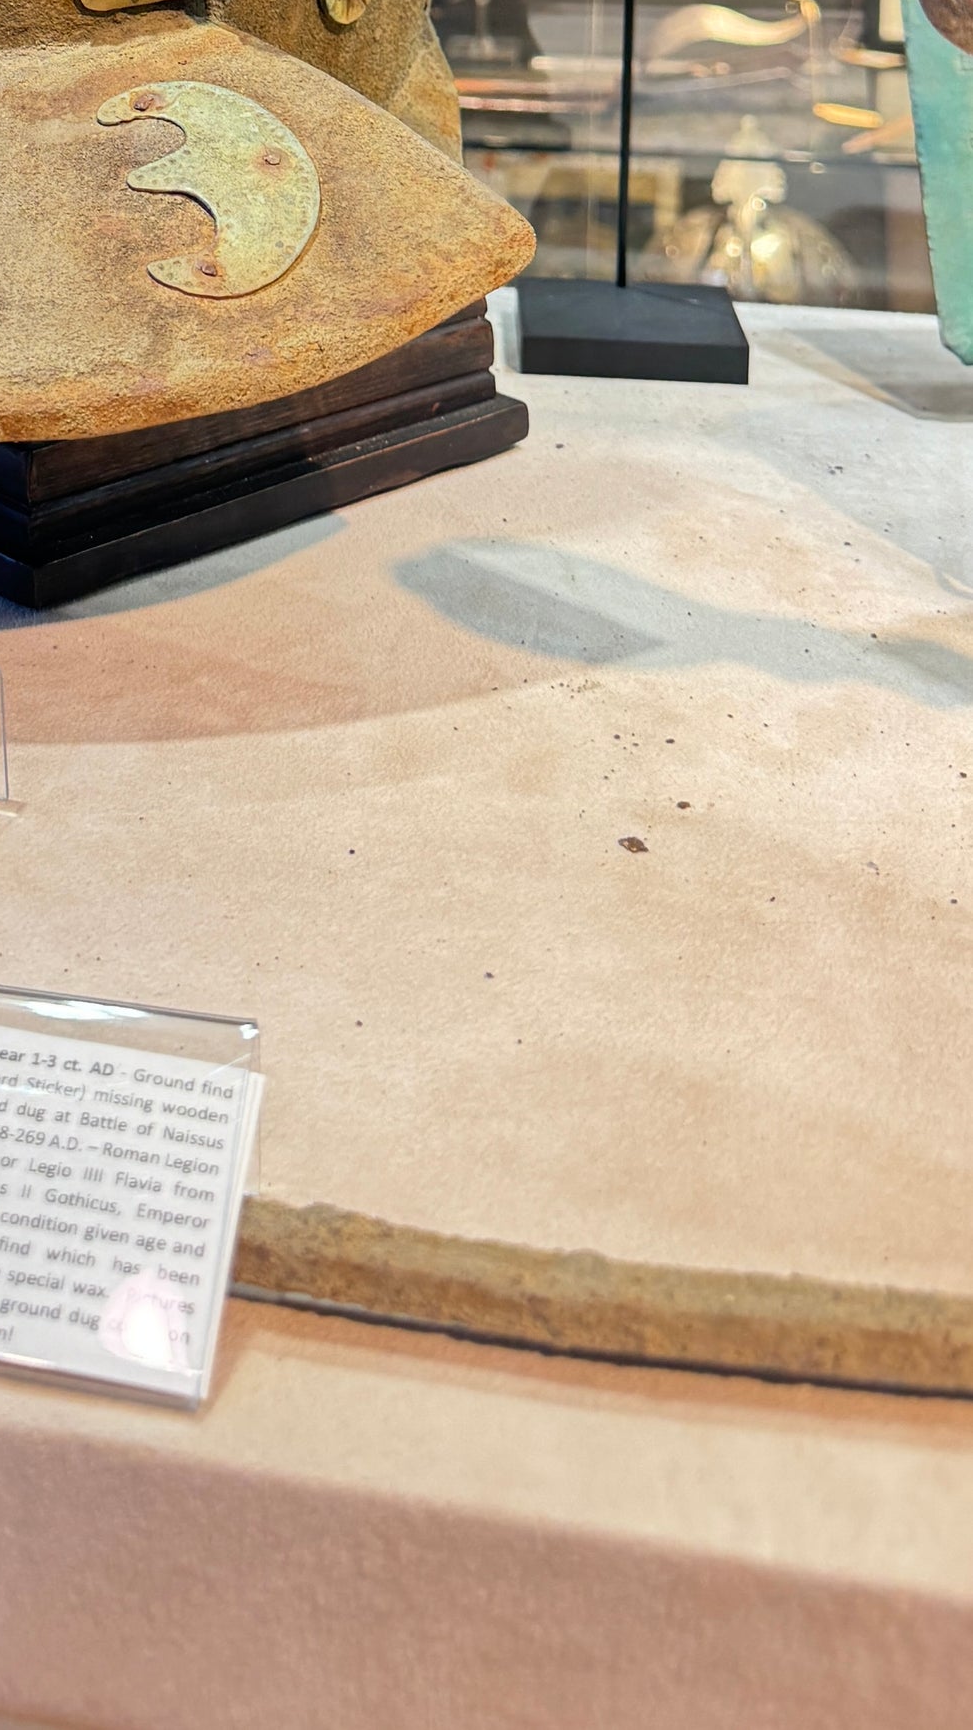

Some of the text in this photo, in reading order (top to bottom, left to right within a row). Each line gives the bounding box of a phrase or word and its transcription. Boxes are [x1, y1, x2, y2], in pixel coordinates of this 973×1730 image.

[30, 1051, 58, 1069] 1-3
[61, 1058, 83, 1073] ct.
[87, 1060, 115, 1077] AD
[132, 1067, 196, 1092] Ground
[200, 1079, 234, 1100] find
[15, 1101, 47, 1123] dug
[52, 1110, 72, 1124] at
[78, 1110, 128, 1133] Battle
[135, 1121, 156, 1137] of
[161, 1125, 224, 1151] Naissus
[92, 1088, 154, 1114] missing
[161, 1102, 229, 1124] wooden
[19, 1183, 32, 1199] II
[43, 1187, 121, 1217] Gothicus,
[135, 1202, 211, 1229] Emperor
